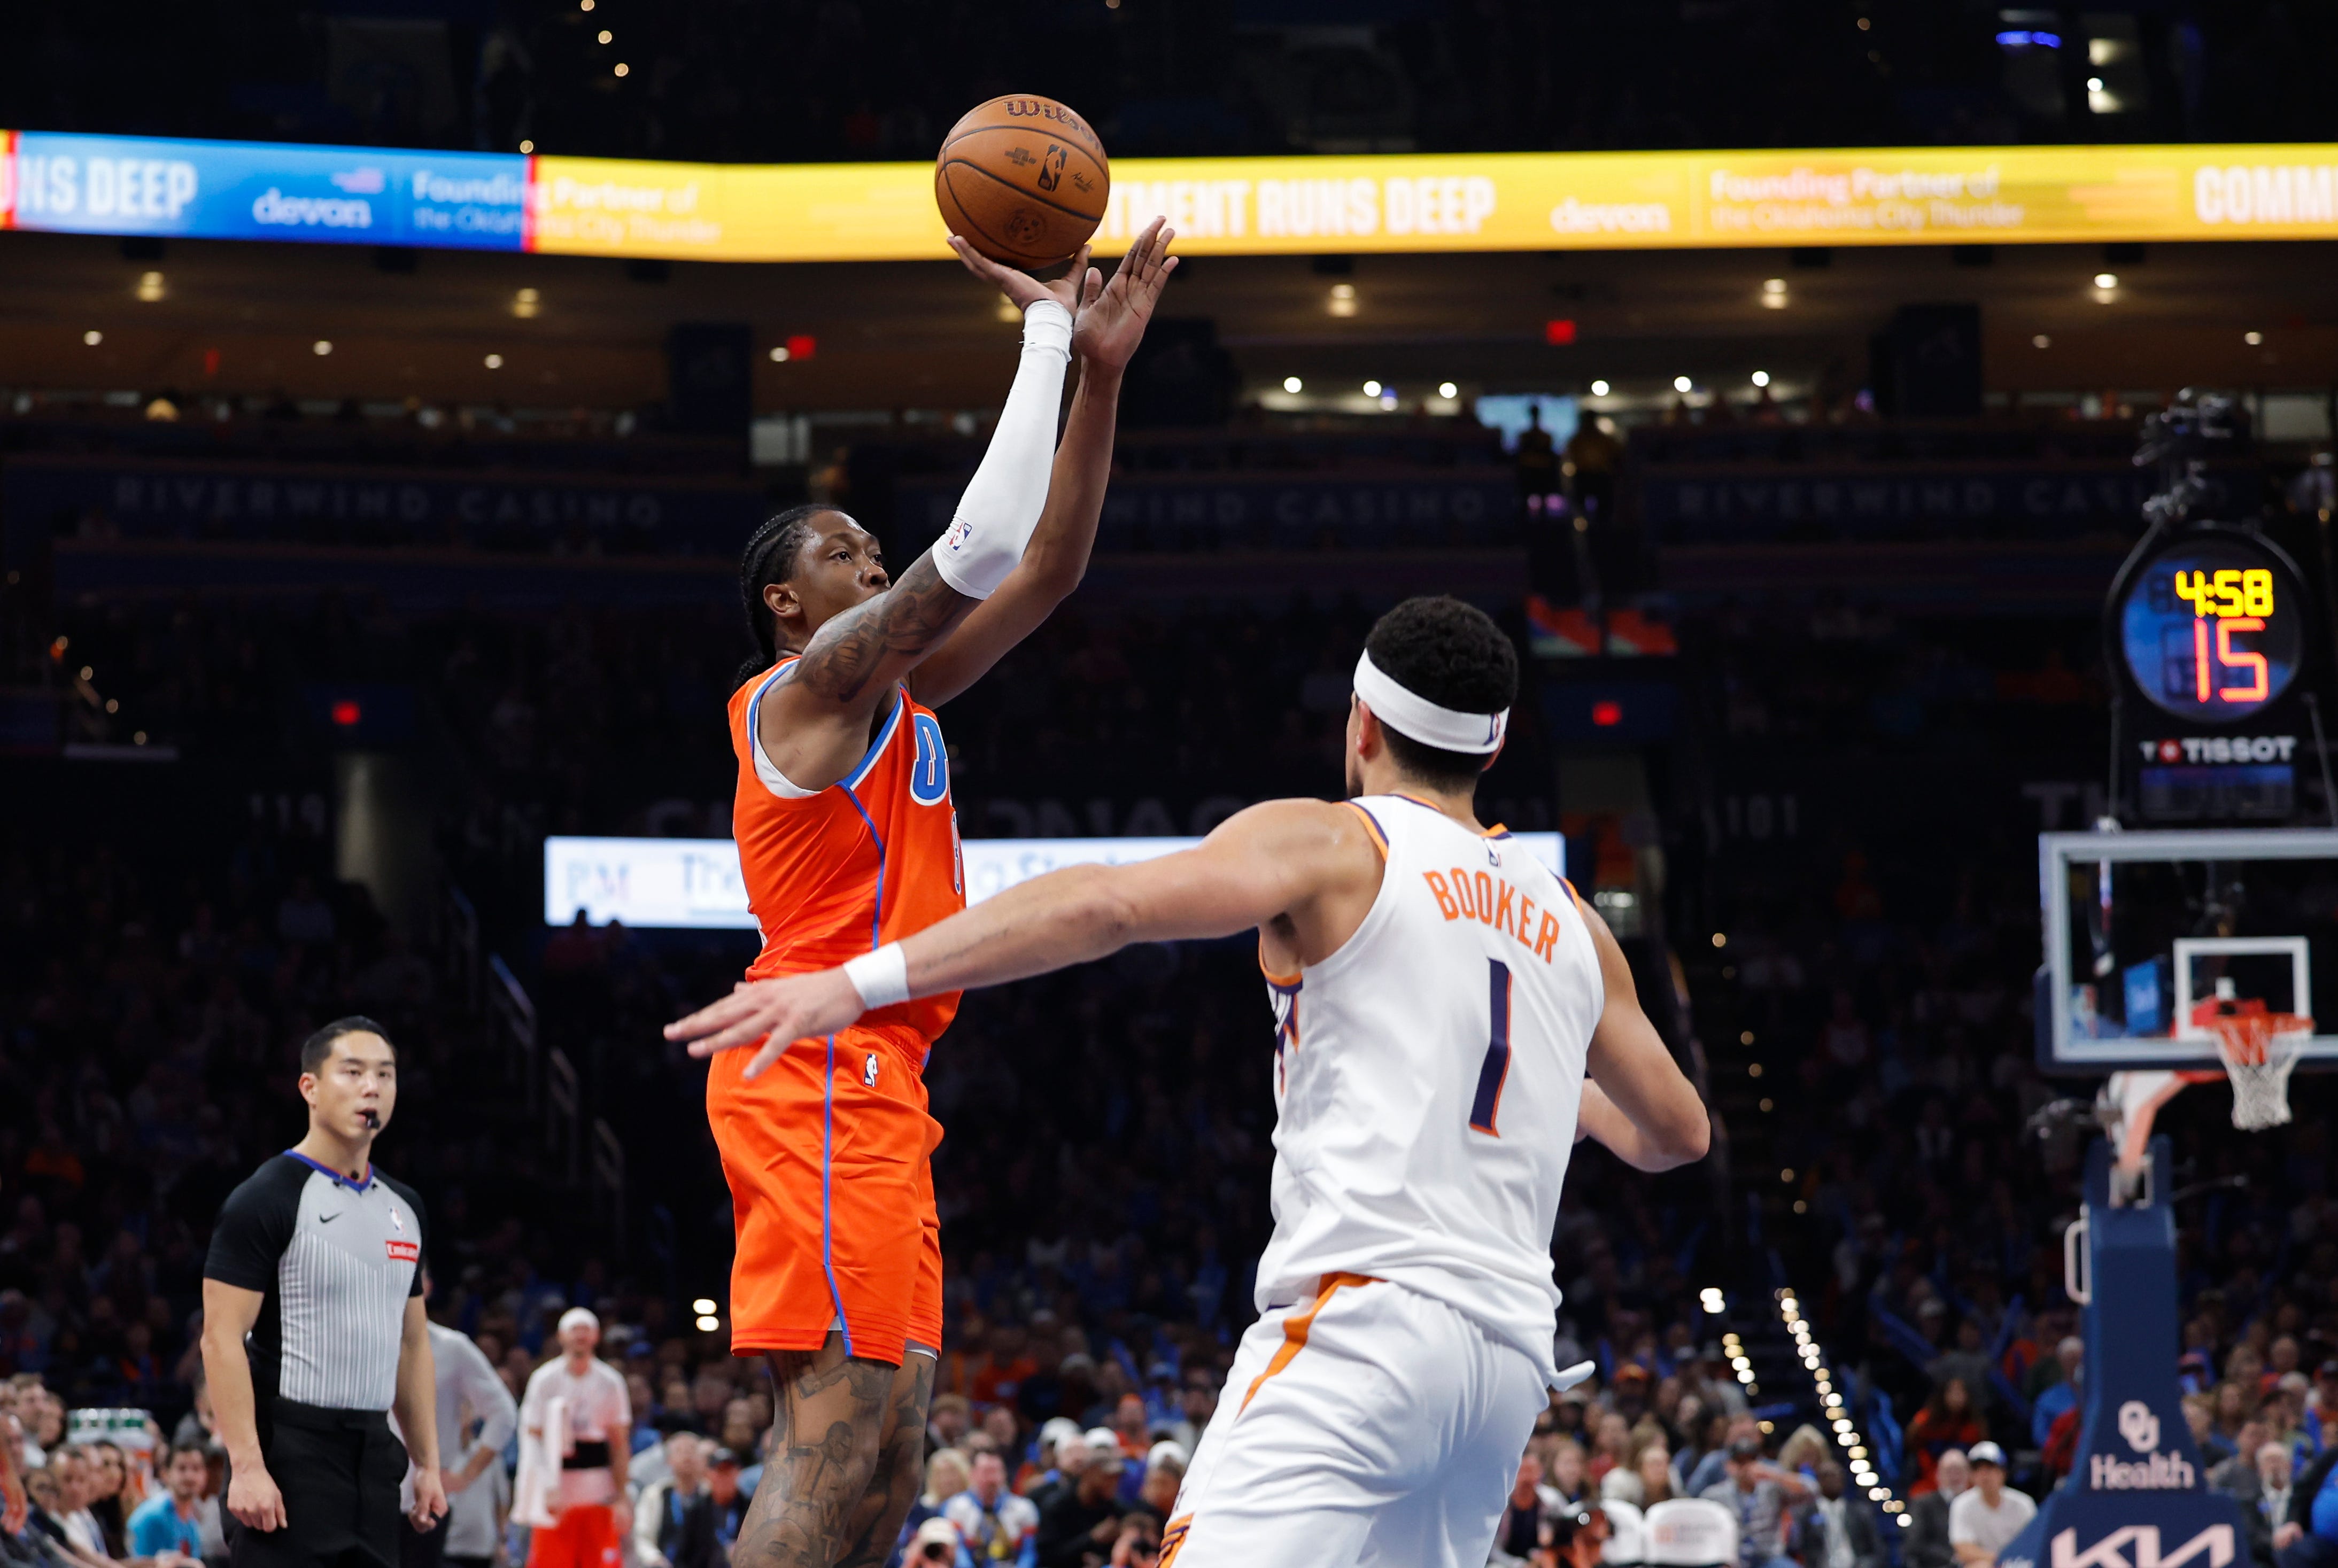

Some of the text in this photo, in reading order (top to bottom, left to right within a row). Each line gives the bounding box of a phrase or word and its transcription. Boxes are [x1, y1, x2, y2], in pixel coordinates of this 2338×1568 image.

[87, 157, 198, 219] DEEP
[252, 187, 371, 229] devon
[412, 172, 549, 212] Founding
[553, 177, 663, 210] Partner
[1096, 180, 1251, 238] TMENT
[1257, 178, 1378, 236] RUNS
[1384, 176, 1496, 235] DEEP
[1710, 168, 1851, 206] Founding
[1852, 167, 1963, 199] Partner
[2195, 165, 2338, 225] COMM
[1550, 198, 1671, 234] devon
[116, 477, 660, 530] RIVERWIND CASINO
[1276, 487, 1484, 525] CASINO
[1677, 479, 1995, 515] RIVERWIND
[2176, 569, 2273, 617] 4:58
[2194, 617, 2269, 702] 15
[2182, 736, 2295, 763] TISSOT
[1422, 867, 1560, 965] BOOKER
[1468, 956, 1513, 1139] 1
[2091, 1450, 2195, 1491] Health
